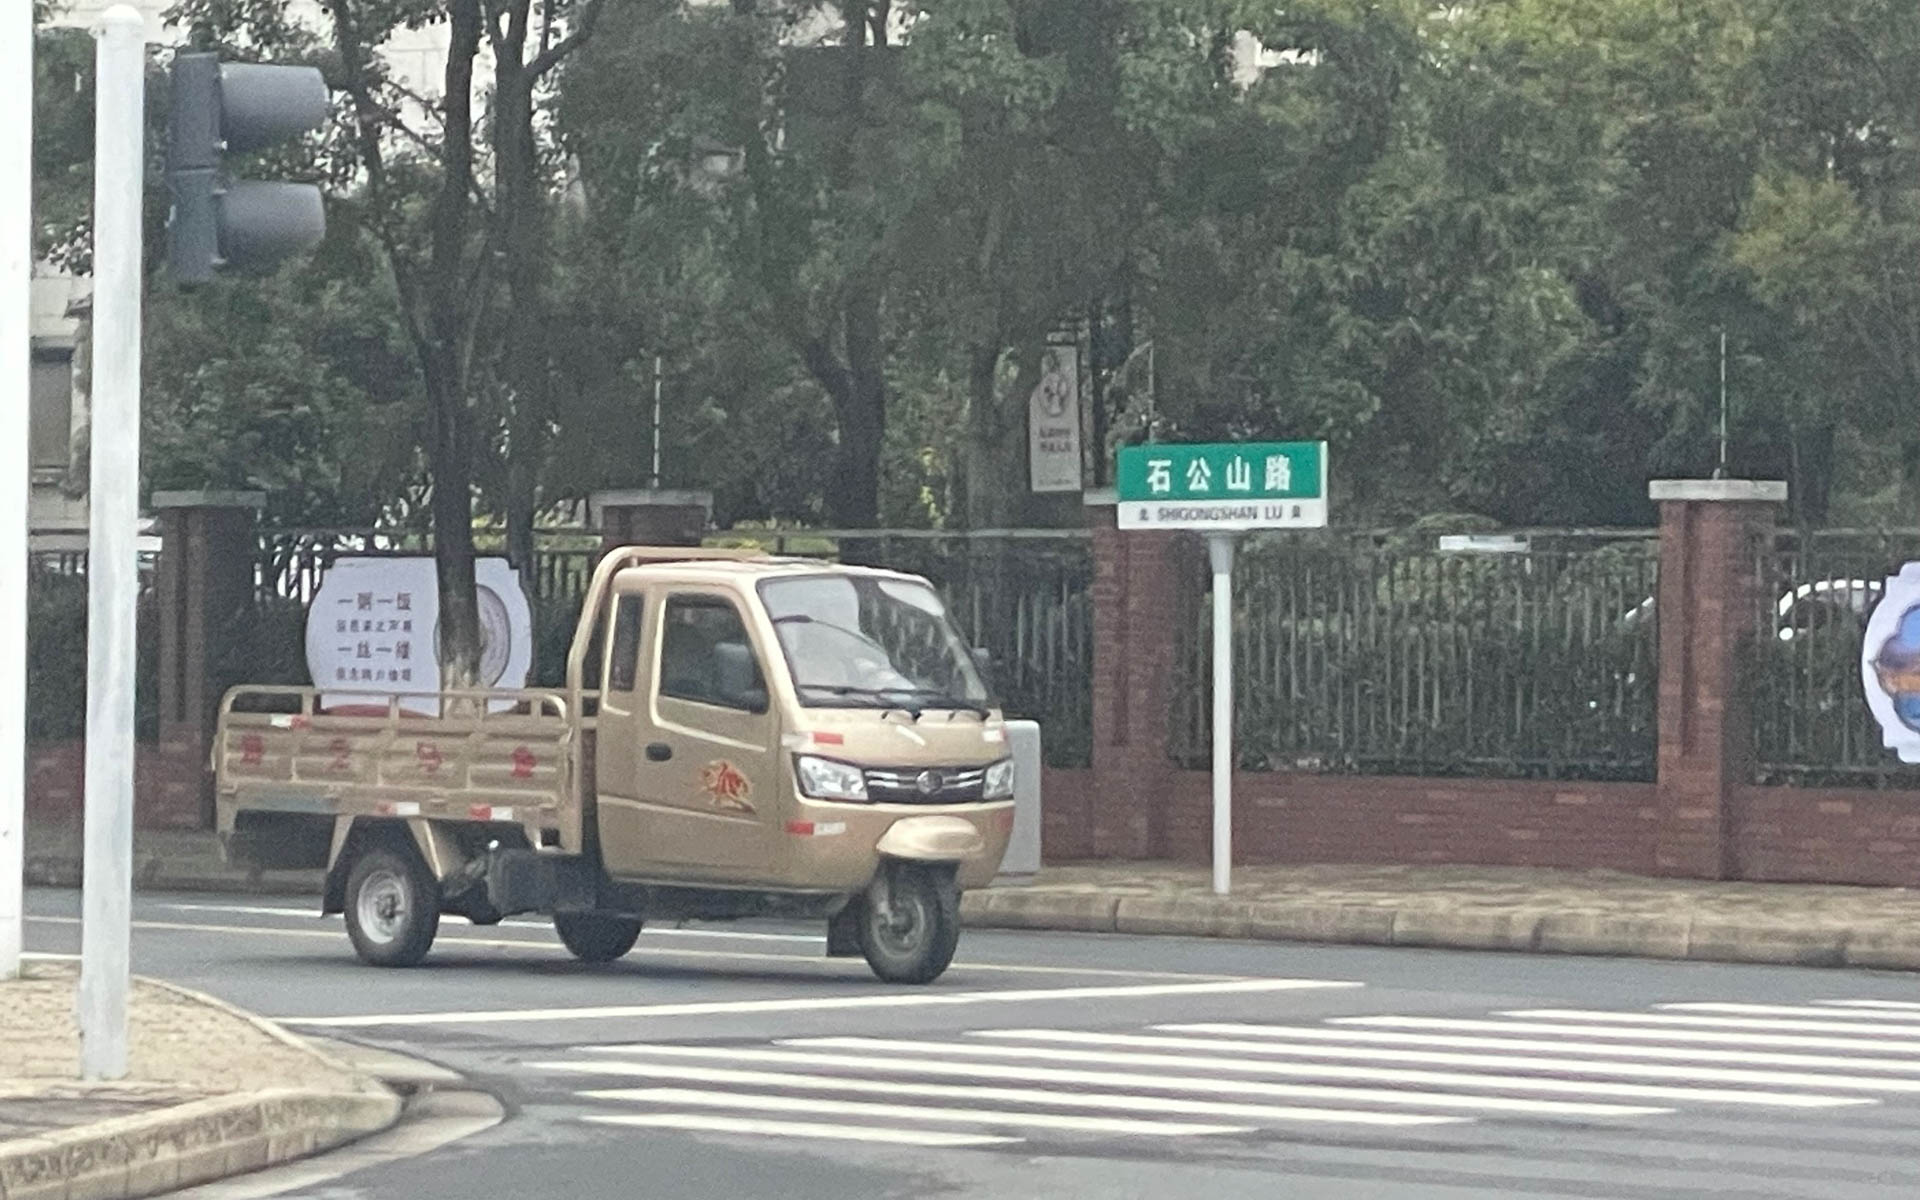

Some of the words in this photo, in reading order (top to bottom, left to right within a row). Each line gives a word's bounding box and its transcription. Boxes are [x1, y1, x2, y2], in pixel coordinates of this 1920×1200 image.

[1147, 454, 1291, 492] 石公山路
[1157, 505, 1258, 521] SHIGONGSHAN
[1265, 504, 1283, 520] LU
